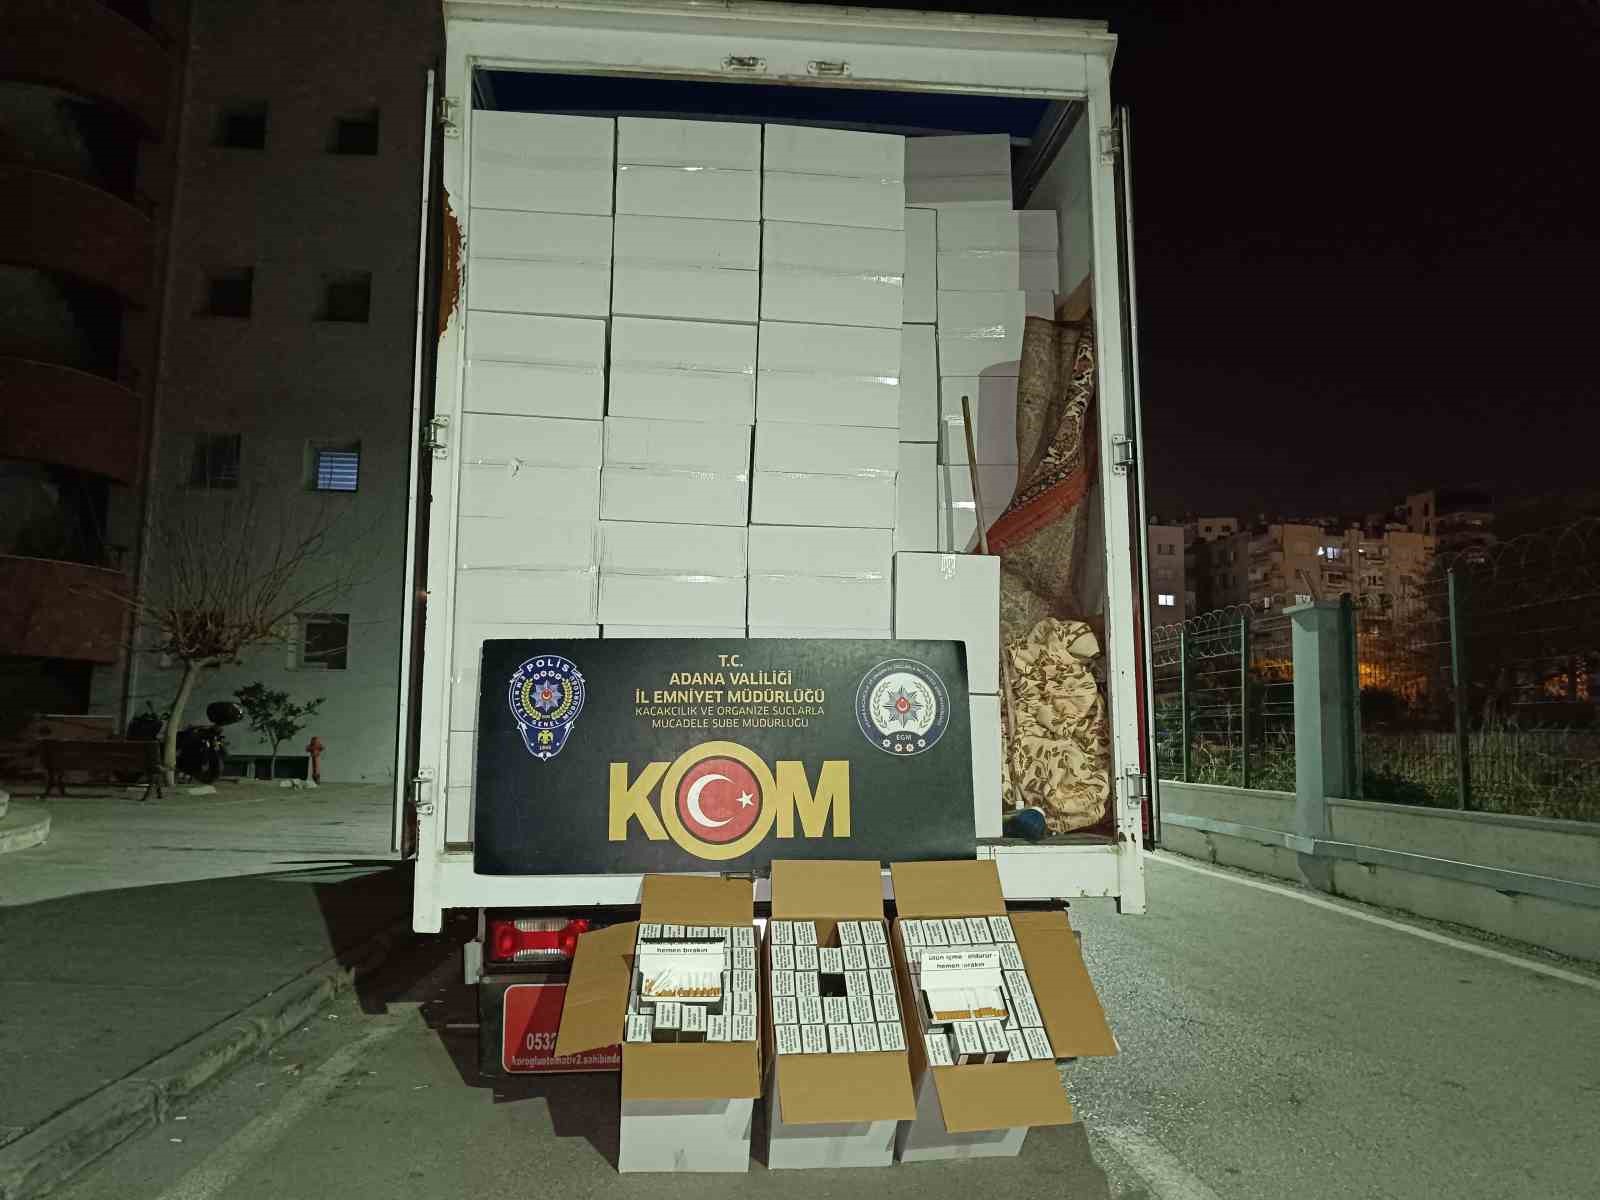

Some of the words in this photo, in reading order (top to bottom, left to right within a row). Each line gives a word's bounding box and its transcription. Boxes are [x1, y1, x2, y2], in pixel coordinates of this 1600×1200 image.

[526, 658, 571, 673] POLİS
[718, 654, 744, 668] T.C.
[669, 672, 726, 686] ADANA
[729, 669, 793, 686] VALİLİĞİ
[635, 688, 650, 704] İL
[653, 688, 724, 704] EMNİYET
[727, 687, 826, 704] MÜDÜRLÜĞÜ
[700, 705, 714, 716] VE
[896, 733, 912, 741] EGM
[608, 740, 852, 861] KOM
